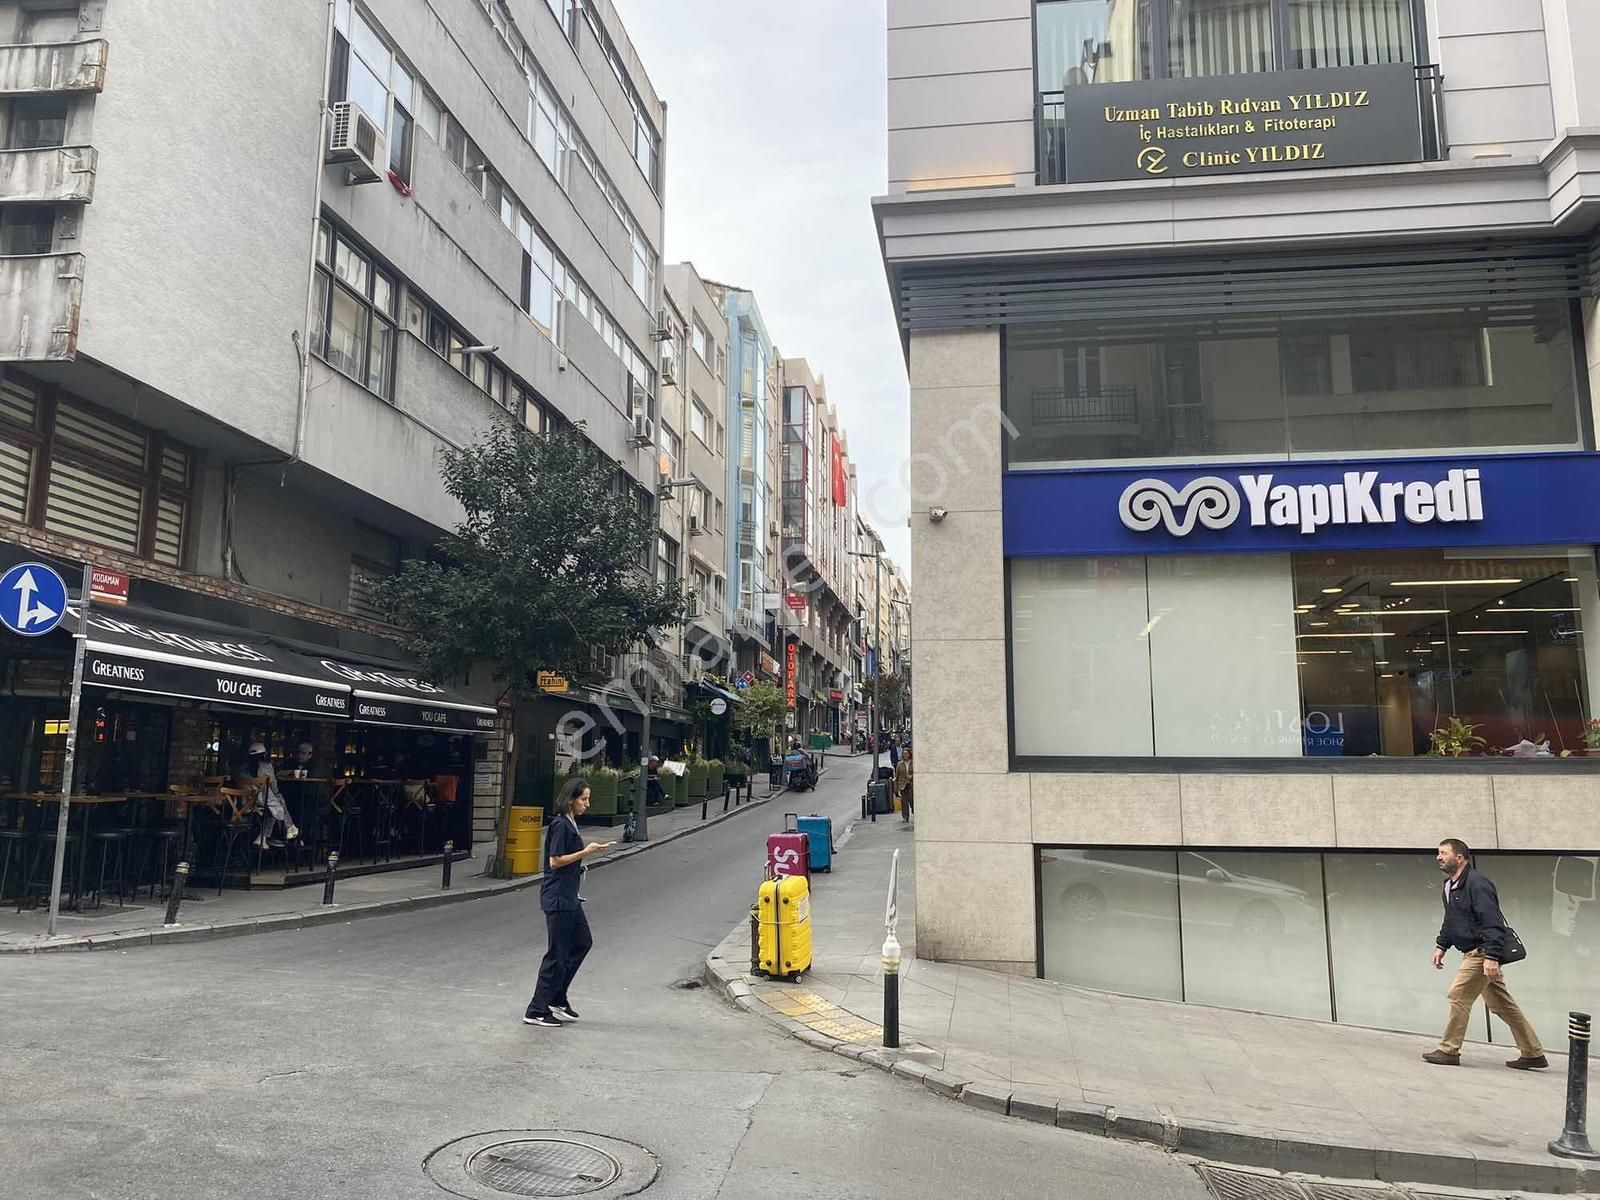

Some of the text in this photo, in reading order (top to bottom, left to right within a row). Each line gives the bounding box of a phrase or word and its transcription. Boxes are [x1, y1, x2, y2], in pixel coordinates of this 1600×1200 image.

[1104, 90, 1370, 123] Uzman Tabib Rıdvan YILDIZ
[1139, 115, 1337, 143] İç Hastalıkları & Fitoterapi
[1182, 143, 1325, 168] Clinic YILDIZ
[92, 572, 120, 586] KODAMAN
[92, 659, 145, 682] GREATNESS
[787, 643, 795, 707] OTOPARK
[216, 679, 262, 698] YOU CAFE
[315, 693, 345, 709] GREATNESS
[358, 703, 387, 717] GREATNESS
[421, 710, 447, 724] YOU CAFE
